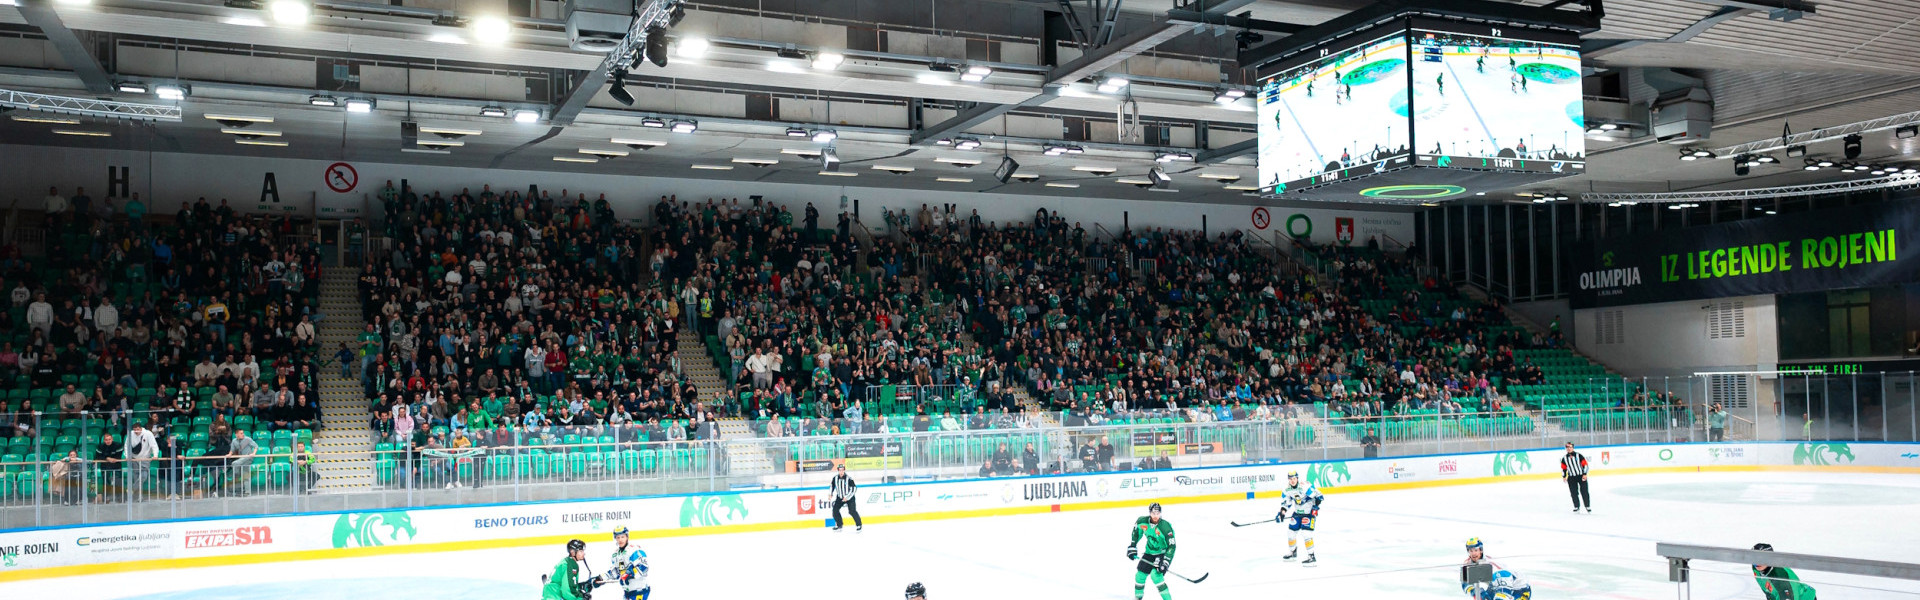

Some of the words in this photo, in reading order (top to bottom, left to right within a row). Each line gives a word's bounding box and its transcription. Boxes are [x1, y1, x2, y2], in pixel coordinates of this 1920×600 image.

[1661, 254, 1679, 283] IZ
[1687, 241, 1792, 280] LEGENDE
[1802, 229, 1896, 270] ROJENI
[1580, 267, 1641, 290] OLIMPIJA
[1834, 364, 1862, 375] FIRE!
[1134, 477, 1159, 488] LPP
[884, 491, 913, 503] LPP
[1024, 481, 1088, 501] LJUBLJANA
[475, 517, 508, 528] BENO
[511, 515, 549, 527] TOURS
[562, 514, 569, 523] IZ
[571, 512, 603, 522] LEGENDE
[606, 511, 631, 521] ROJENI
[91, 534, 137, 544] energetika
[186, 534, 233, 548] EKIPA
[24, 542, 59, 555] ROJENI
